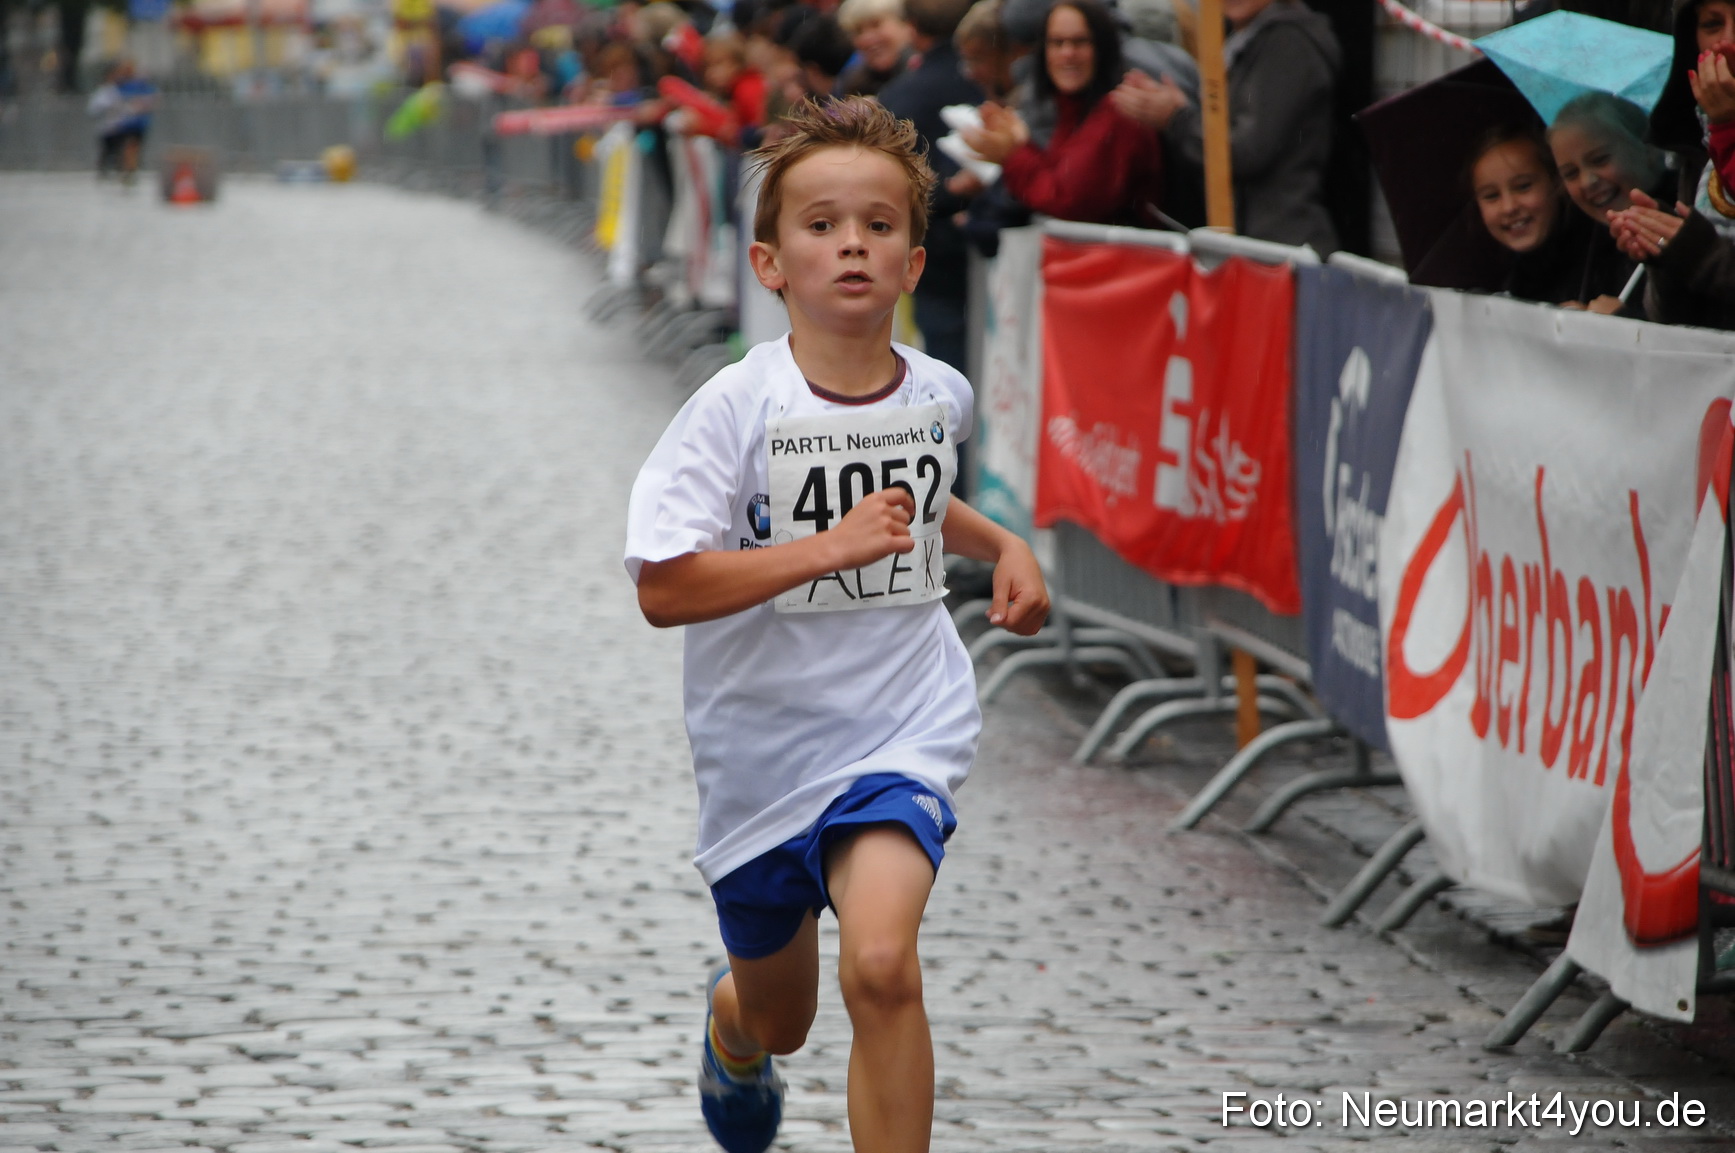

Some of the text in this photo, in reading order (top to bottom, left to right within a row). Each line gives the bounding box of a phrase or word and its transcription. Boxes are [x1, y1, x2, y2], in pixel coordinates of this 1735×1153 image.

[771, 435, 841, 456] PARTL
[848, 427, 926, 450] Neumarkt
[793, 454, 942, 535] 4052
